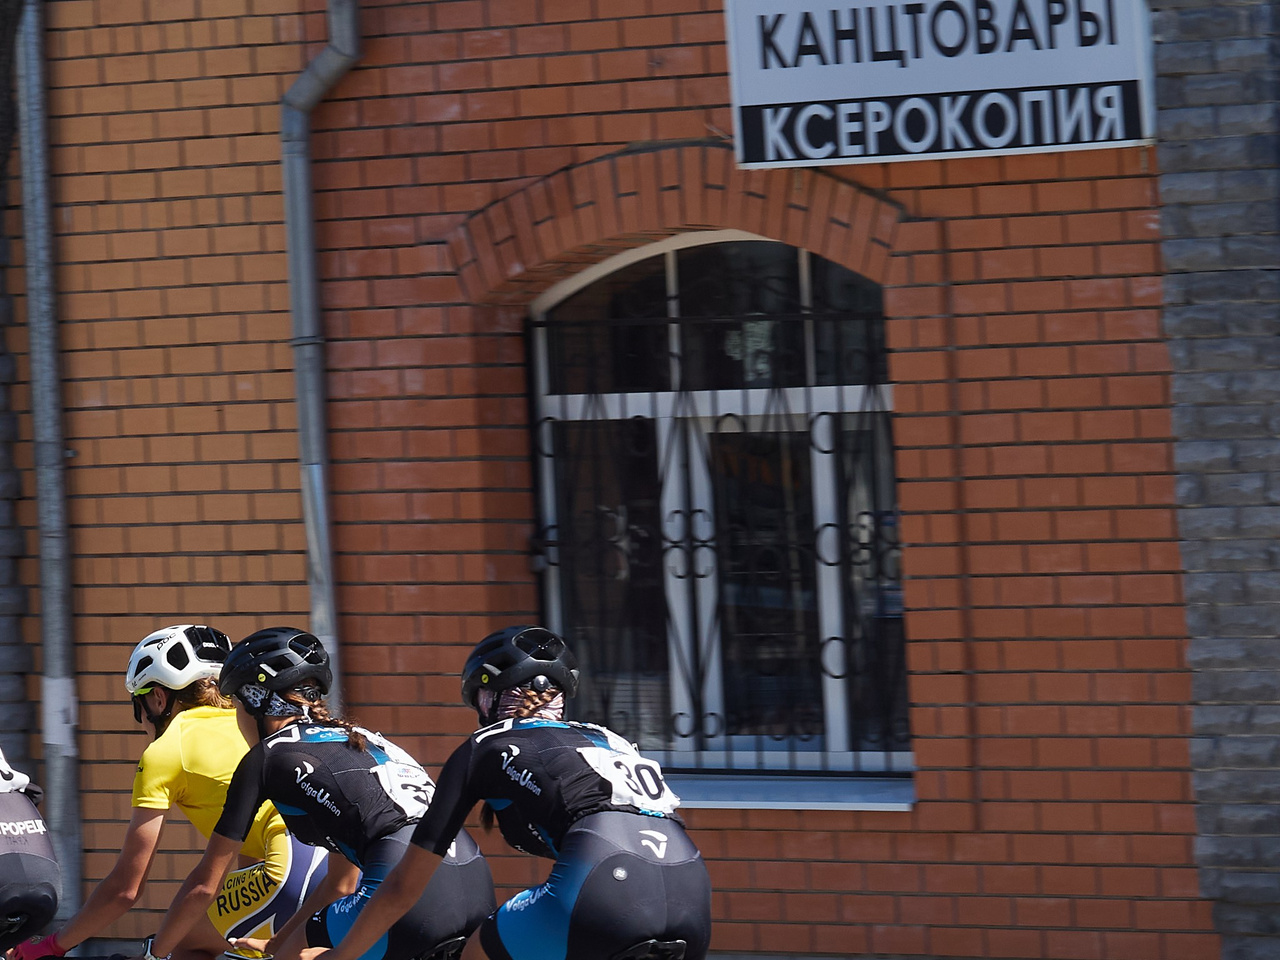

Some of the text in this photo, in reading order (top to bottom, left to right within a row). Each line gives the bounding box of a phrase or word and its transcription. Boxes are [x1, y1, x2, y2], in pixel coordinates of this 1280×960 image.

[756, 0, 1117, 69] КАНЦТОВАРЫ
[762, 85, 1122, 160] КСЕРОКОПИЯ
[613, 761, 666, 800] 30
[216, 872, 277, 917] RUSSIA
